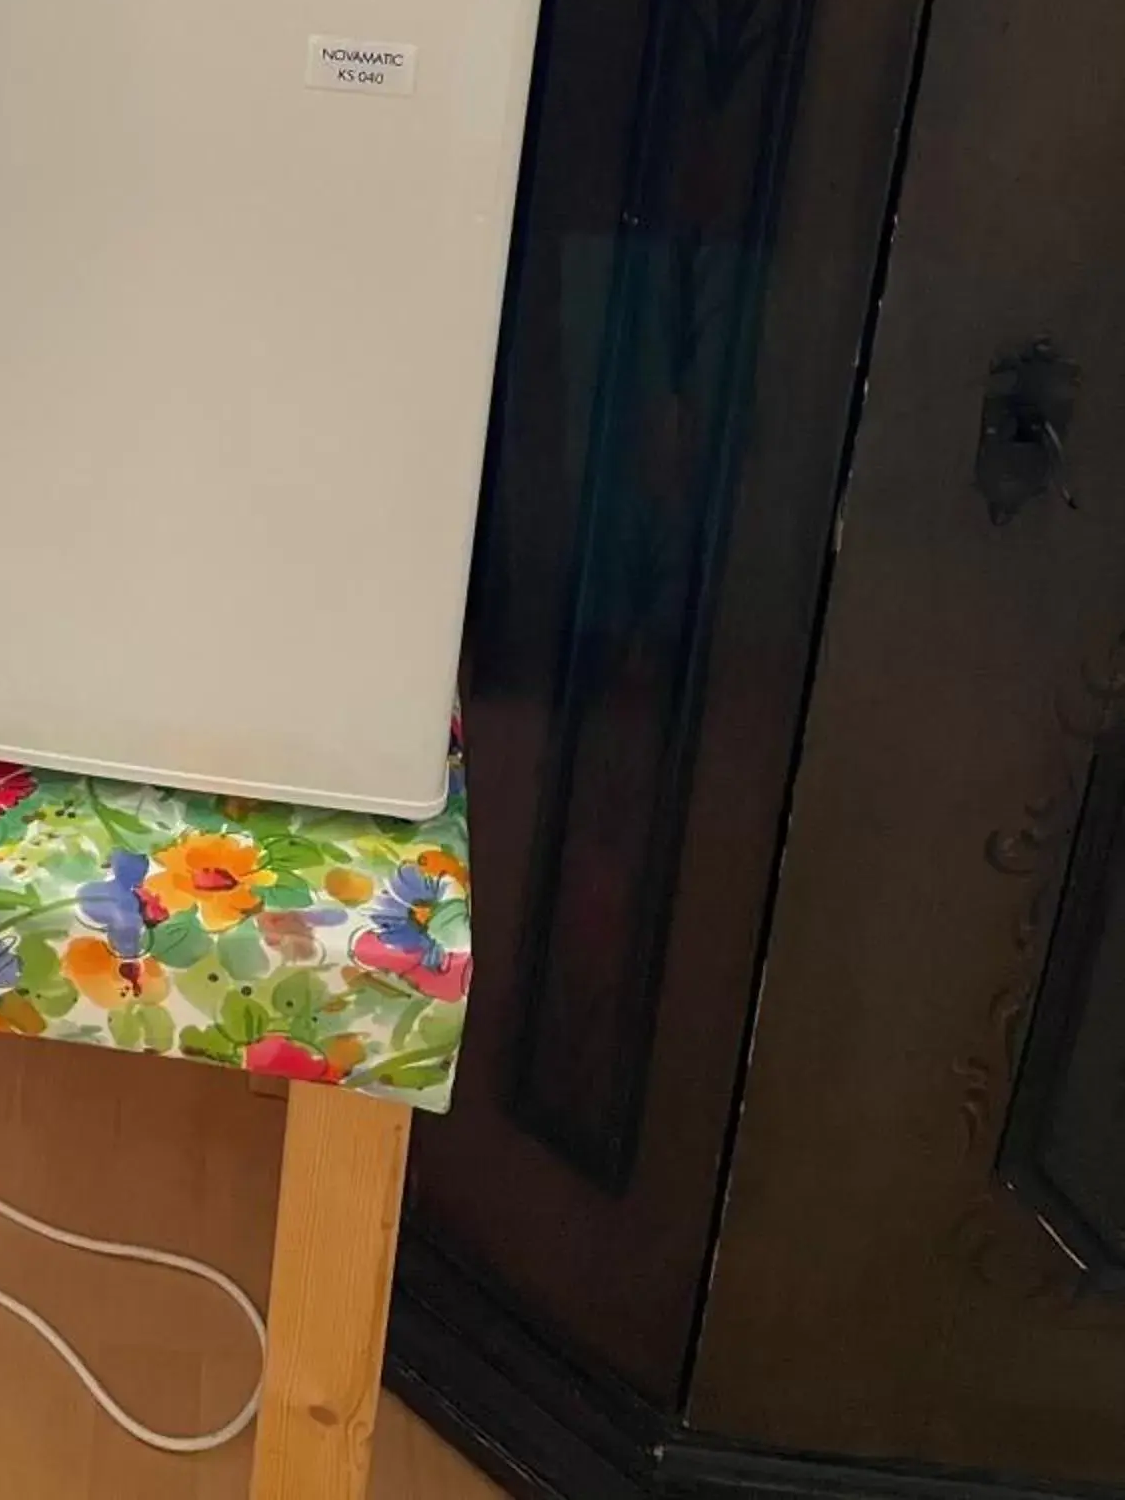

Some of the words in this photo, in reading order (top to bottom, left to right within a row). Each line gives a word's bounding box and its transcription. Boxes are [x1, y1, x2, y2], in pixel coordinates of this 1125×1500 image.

[322, 48, 404, 67] NOVAMATIC
[337, 68, 355, 82] KS
[357, 71, 384, 85] 040
